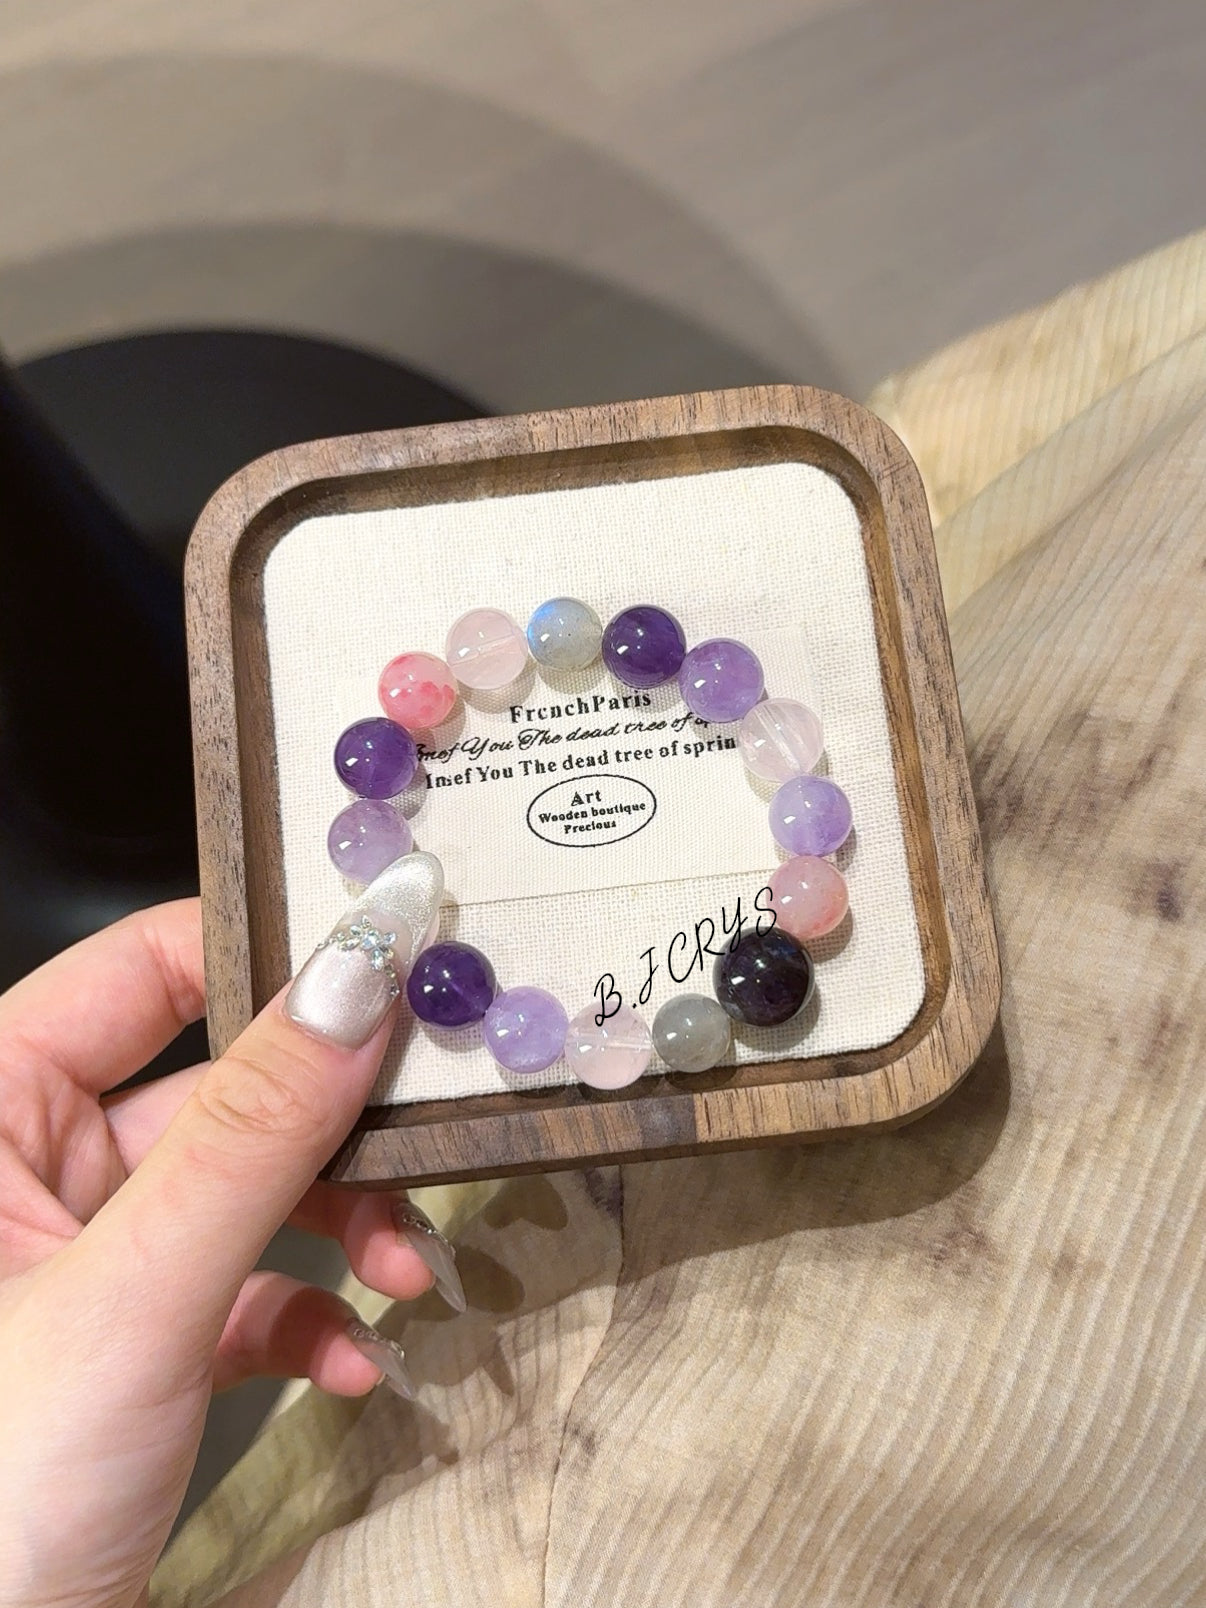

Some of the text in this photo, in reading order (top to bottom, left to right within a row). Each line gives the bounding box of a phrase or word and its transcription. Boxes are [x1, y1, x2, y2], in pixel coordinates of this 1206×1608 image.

[517, 728, 563, 751] The
[565, 727, 619, 742] dead
[623, 721, 668, 734] tree
[670, 711, 695, 732] of
[475, 765, 514, 783] You
[518, 759, 557, 776] The
[562, 749, 609, 771] dead
[615, 747, 654, 763] tree
[659, 740, 679, 758] of
[683, 735, 738, 758] sprin
[570, 789, 602, 807] Art
[538, 802, 646, 824] Wooden boutique
[564, 820, 617, 834] Precious
